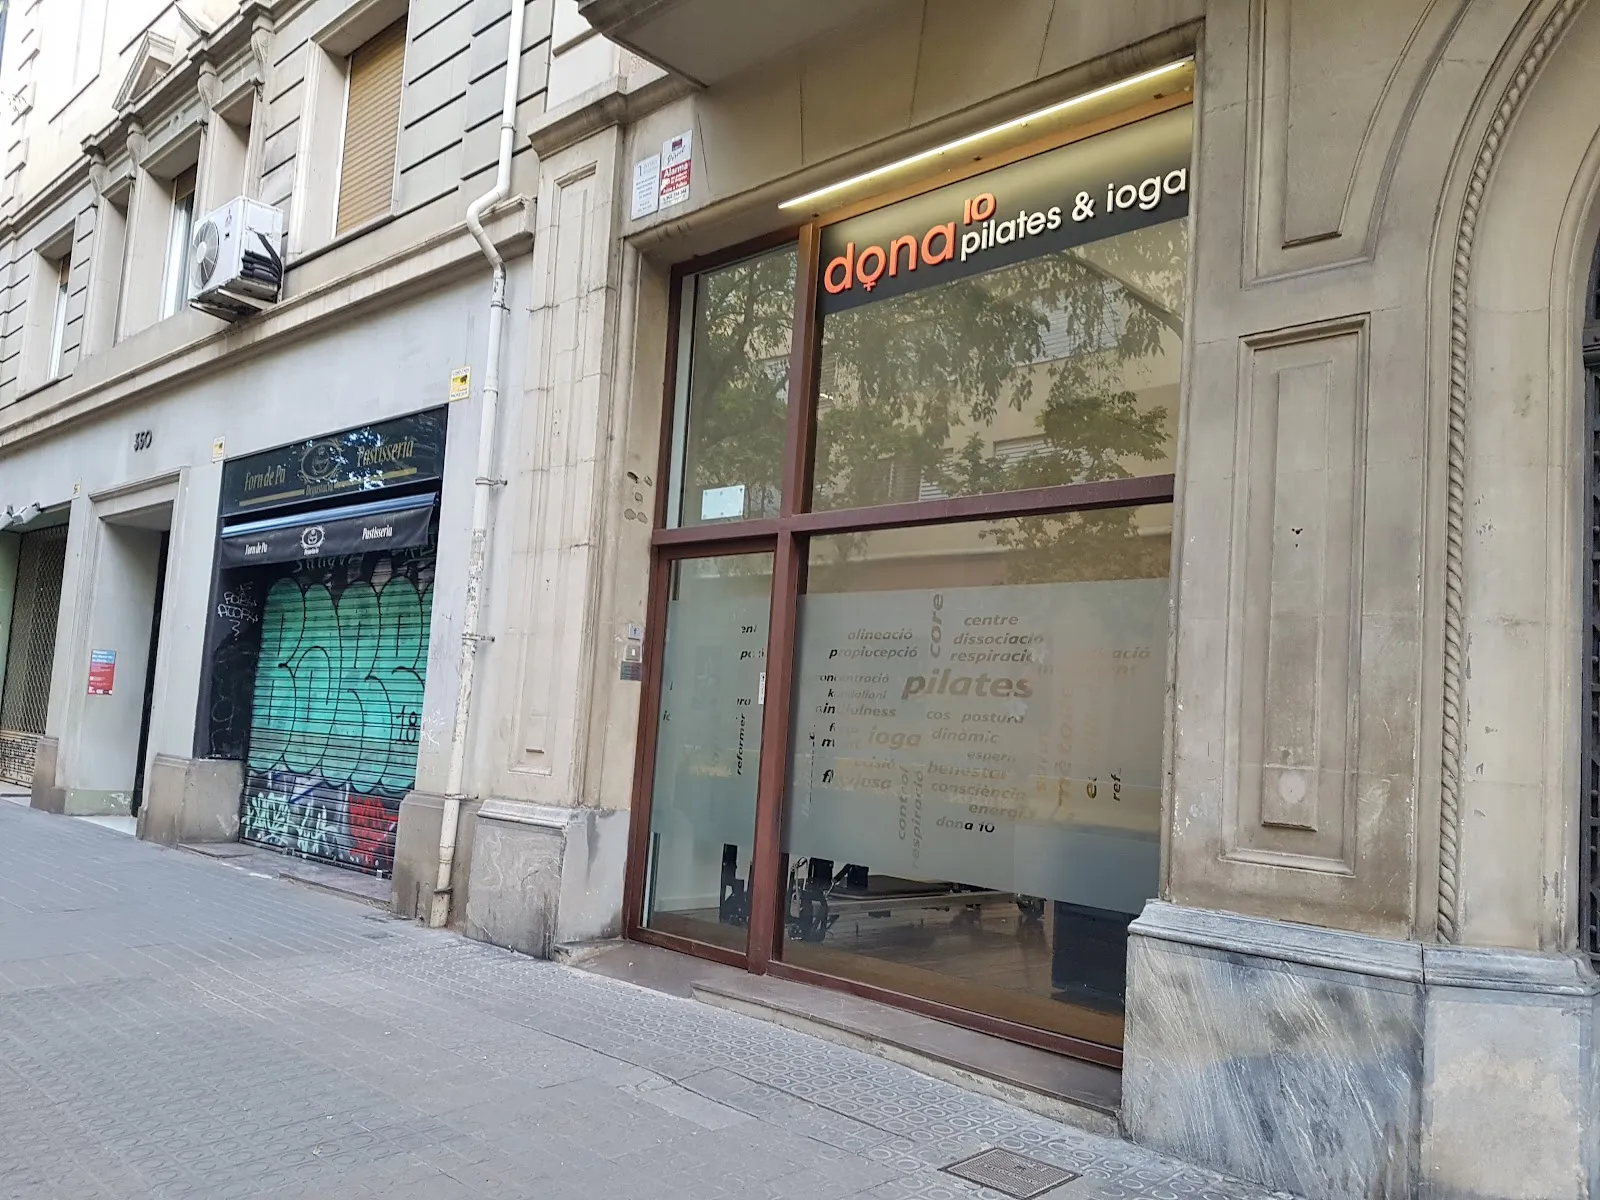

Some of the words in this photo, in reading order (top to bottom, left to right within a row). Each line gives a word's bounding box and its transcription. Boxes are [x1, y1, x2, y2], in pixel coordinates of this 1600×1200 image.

[959, 205, 1062, 262] pilates
[1071, 191, 1096, 222] &
[1105, 167, 1187, 213] ioga
[824, 221, 956, 294] dona
[357, 436, 415, 467] Pastisseria
[245, 471, 263, 491] Forn
[264, 465, 274, 487] de
[275, 464, 286, 485] Pa
[362, 524, 393, 540] Pastisseria
[929, 593, 943, 659] core
[963, 614, 1019, 626] centre
[848, 628, 913, 641] alineació
[901, 668, 1034, 700] pilates
[926, 711, 951, 720] cos
[961, 711, 1025, 723] postura
[868, 725, 922, 749] ioga
[932, 727, 1000, 744] dinàmic
[899, 765, 909, 840] control
[935, 815, 974, 831] dona
[979, 823, 995, 833] 10
